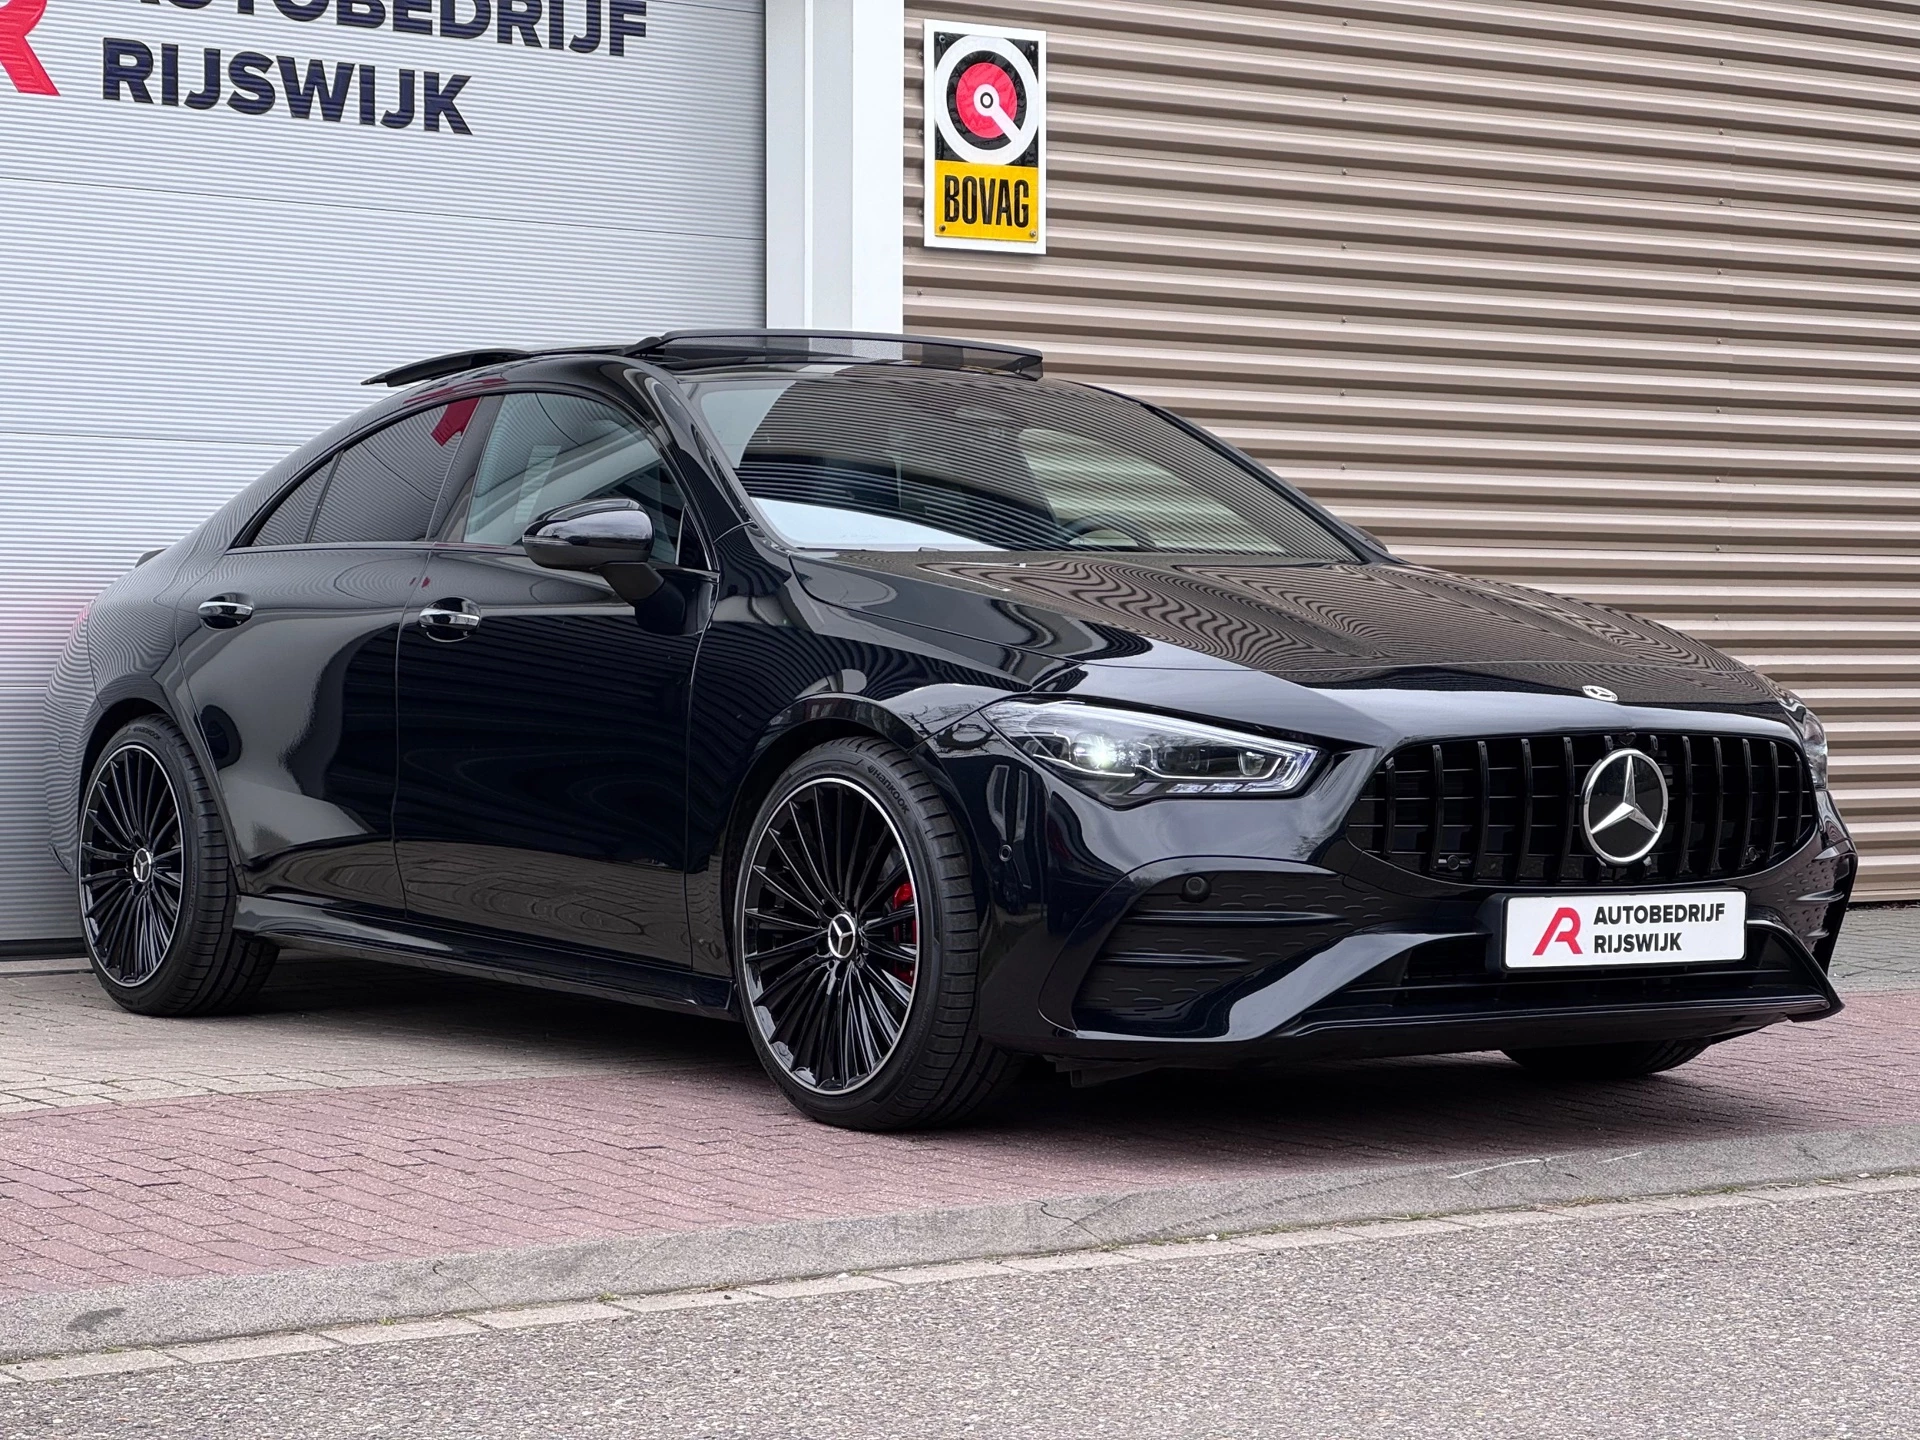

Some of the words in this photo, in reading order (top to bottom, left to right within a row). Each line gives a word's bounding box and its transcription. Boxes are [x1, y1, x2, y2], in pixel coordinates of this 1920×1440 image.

[141, 0, 647, 58] EDRIJF
[102, 37, 473, 136] RIJSWIJK
[944, 174, 1029, 229] BOVAG
[1593, 902, 1726, 925] AUTOBEDRIJF
[1593, 932, 1682, 954] RIJSWIJK
